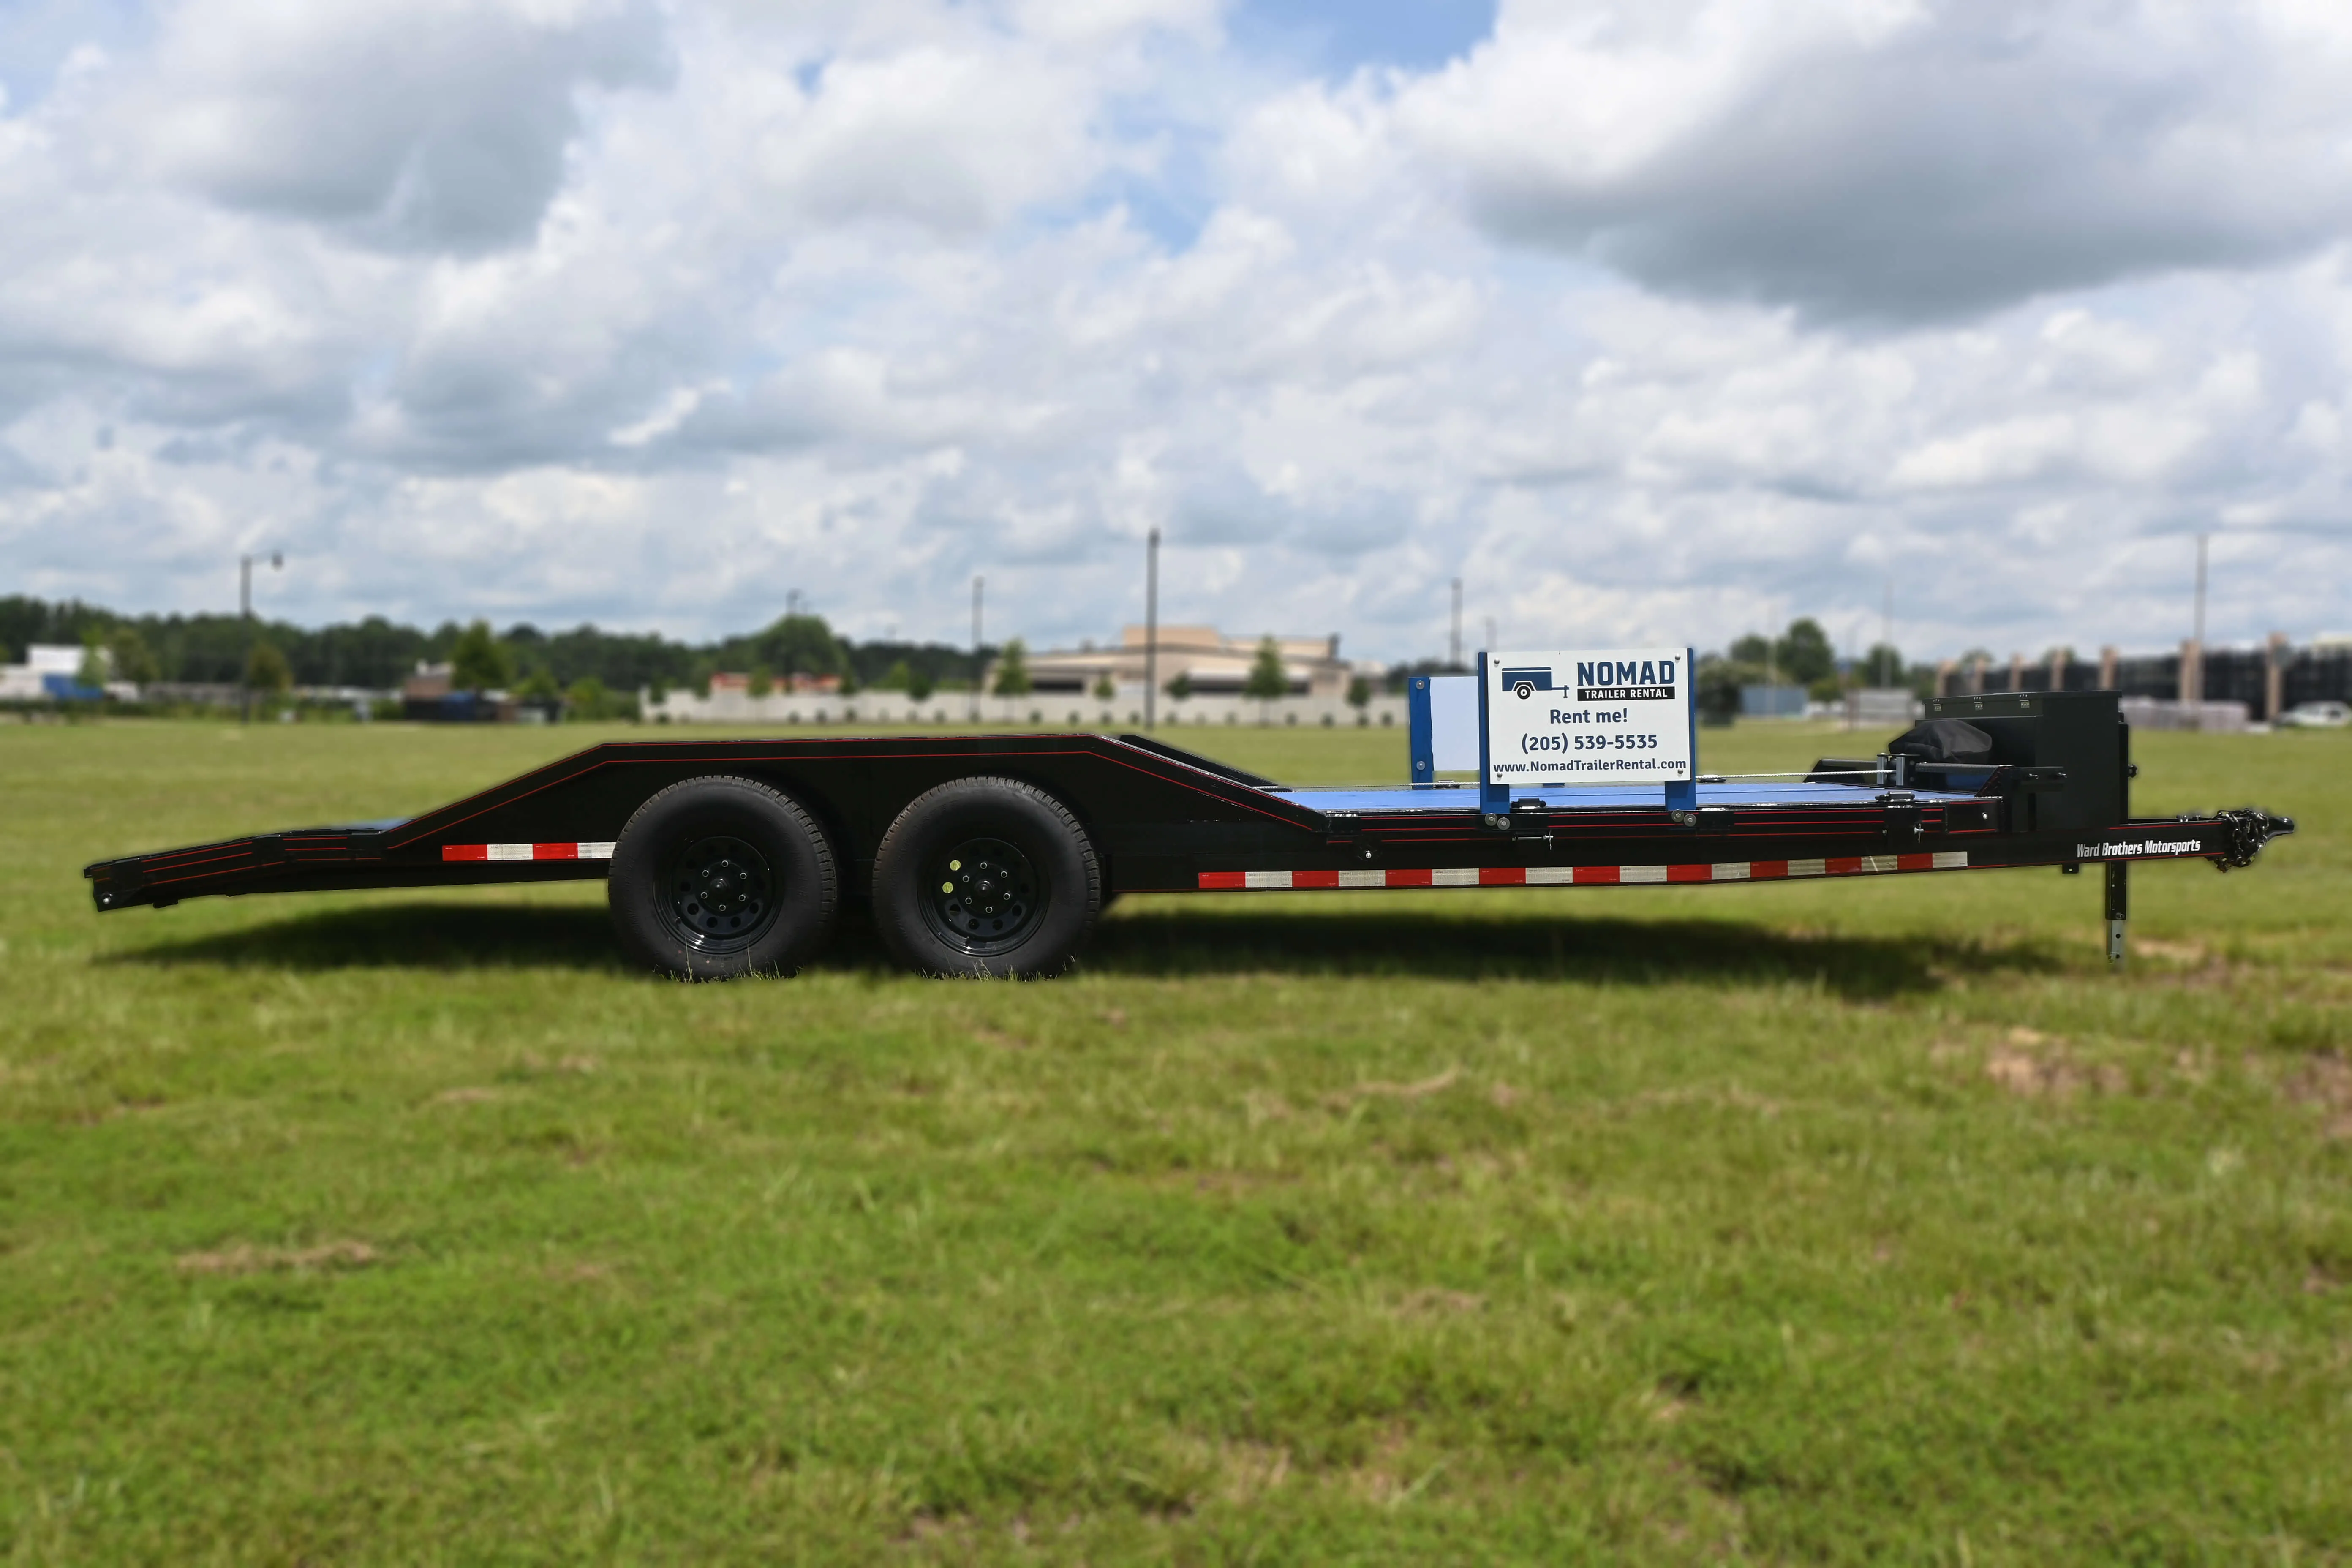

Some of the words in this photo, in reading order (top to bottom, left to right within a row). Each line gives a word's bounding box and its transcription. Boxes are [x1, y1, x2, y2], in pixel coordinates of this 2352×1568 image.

[1577, 660, 1675, 686] NOMAD
[1585, 689, 1626, 699] TRAILER
[1630, 688, 1668, 698] RENTAL
[1550, 709, 1590, 724] Rent
[1596, 708, 1628, 723] me!
[1522, 732, 1568, 754] (205)
[1574, 734, 1658, 750] 539-5535
[1493, 758, 1686, 772] www.NomadTrailerRental.com
[2077, 843, 2100, 858] Ward
[2102, 841, 2143, 856] Brothers
[2144, 839, 2201, 855] Motorsports
